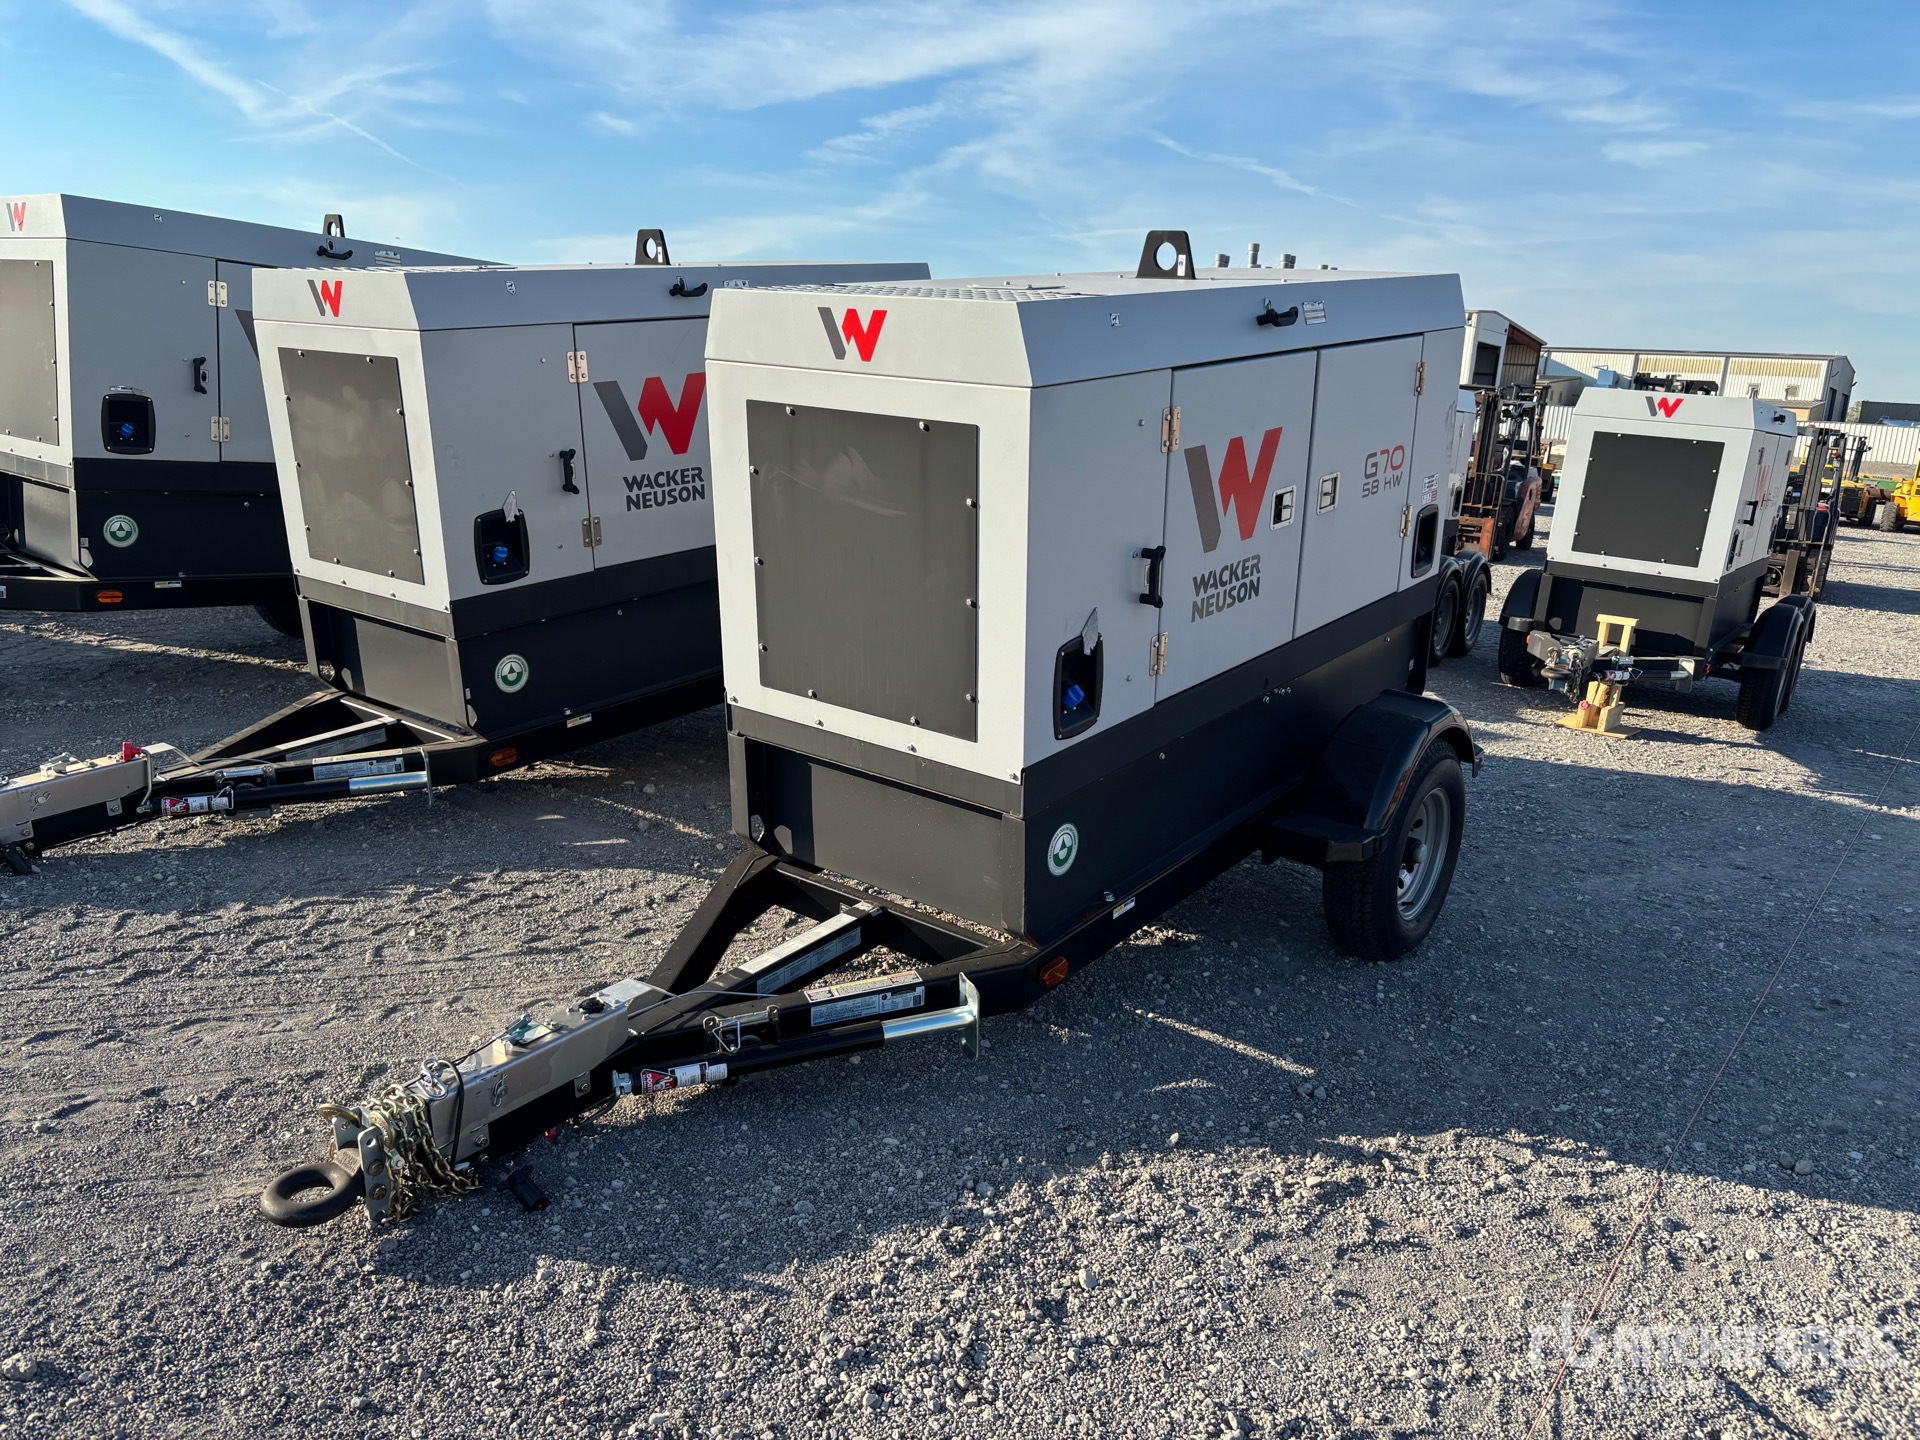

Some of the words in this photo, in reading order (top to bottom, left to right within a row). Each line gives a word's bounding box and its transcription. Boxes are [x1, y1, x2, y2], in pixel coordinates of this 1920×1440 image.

[1364, 445, 1405, 480] G70
[622, 466, 705, 493] WACKER
[1361, 479, 1380, 498] 58
[625, 484, 706, 512] NEUSON
[1192, 554, 1261, 597] WACKER
[1191, 576, 1261, 623] NEUSON
